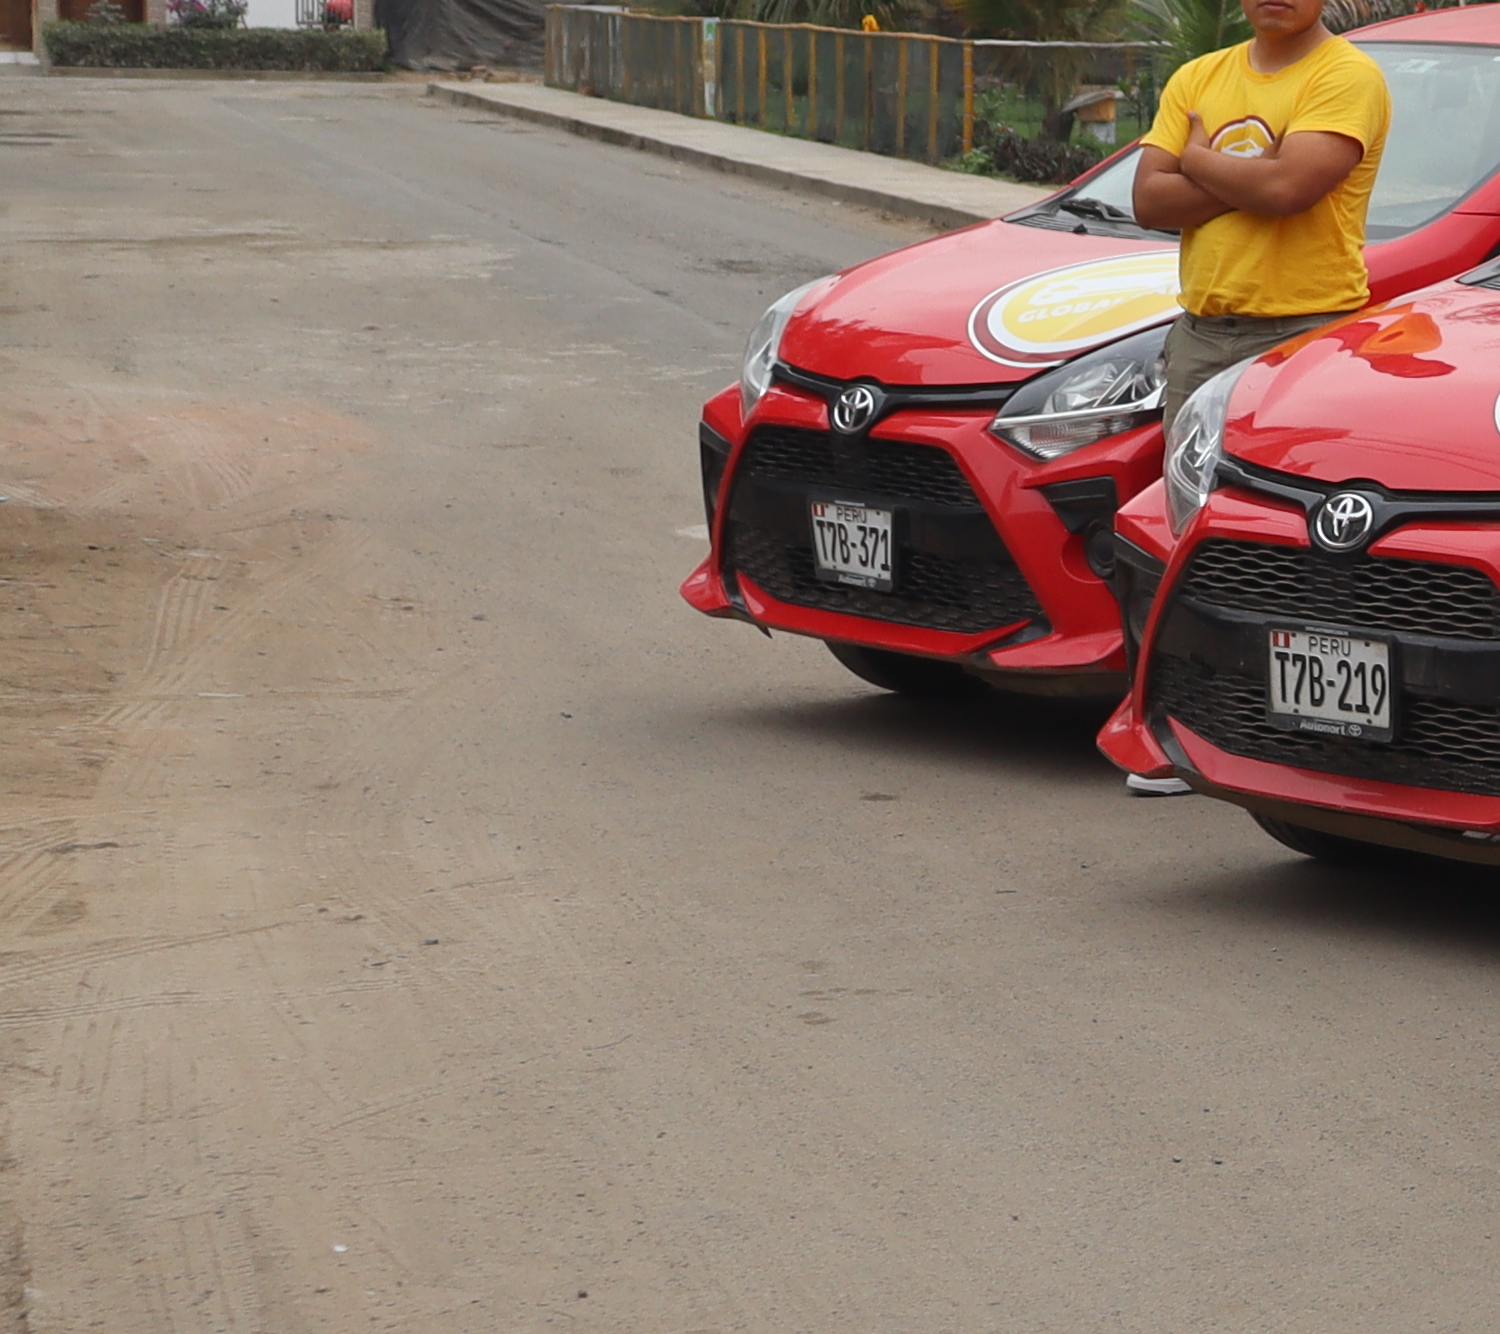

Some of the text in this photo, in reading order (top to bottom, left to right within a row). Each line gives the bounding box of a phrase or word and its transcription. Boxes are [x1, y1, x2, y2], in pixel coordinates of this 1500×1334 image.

[836, 507, 868, 524] PERU
[815, 520, 891, 571] T7B-371
[1308, 636, 1351, 657] PERU
[1274, 651, 1386, 716] T7B-219
